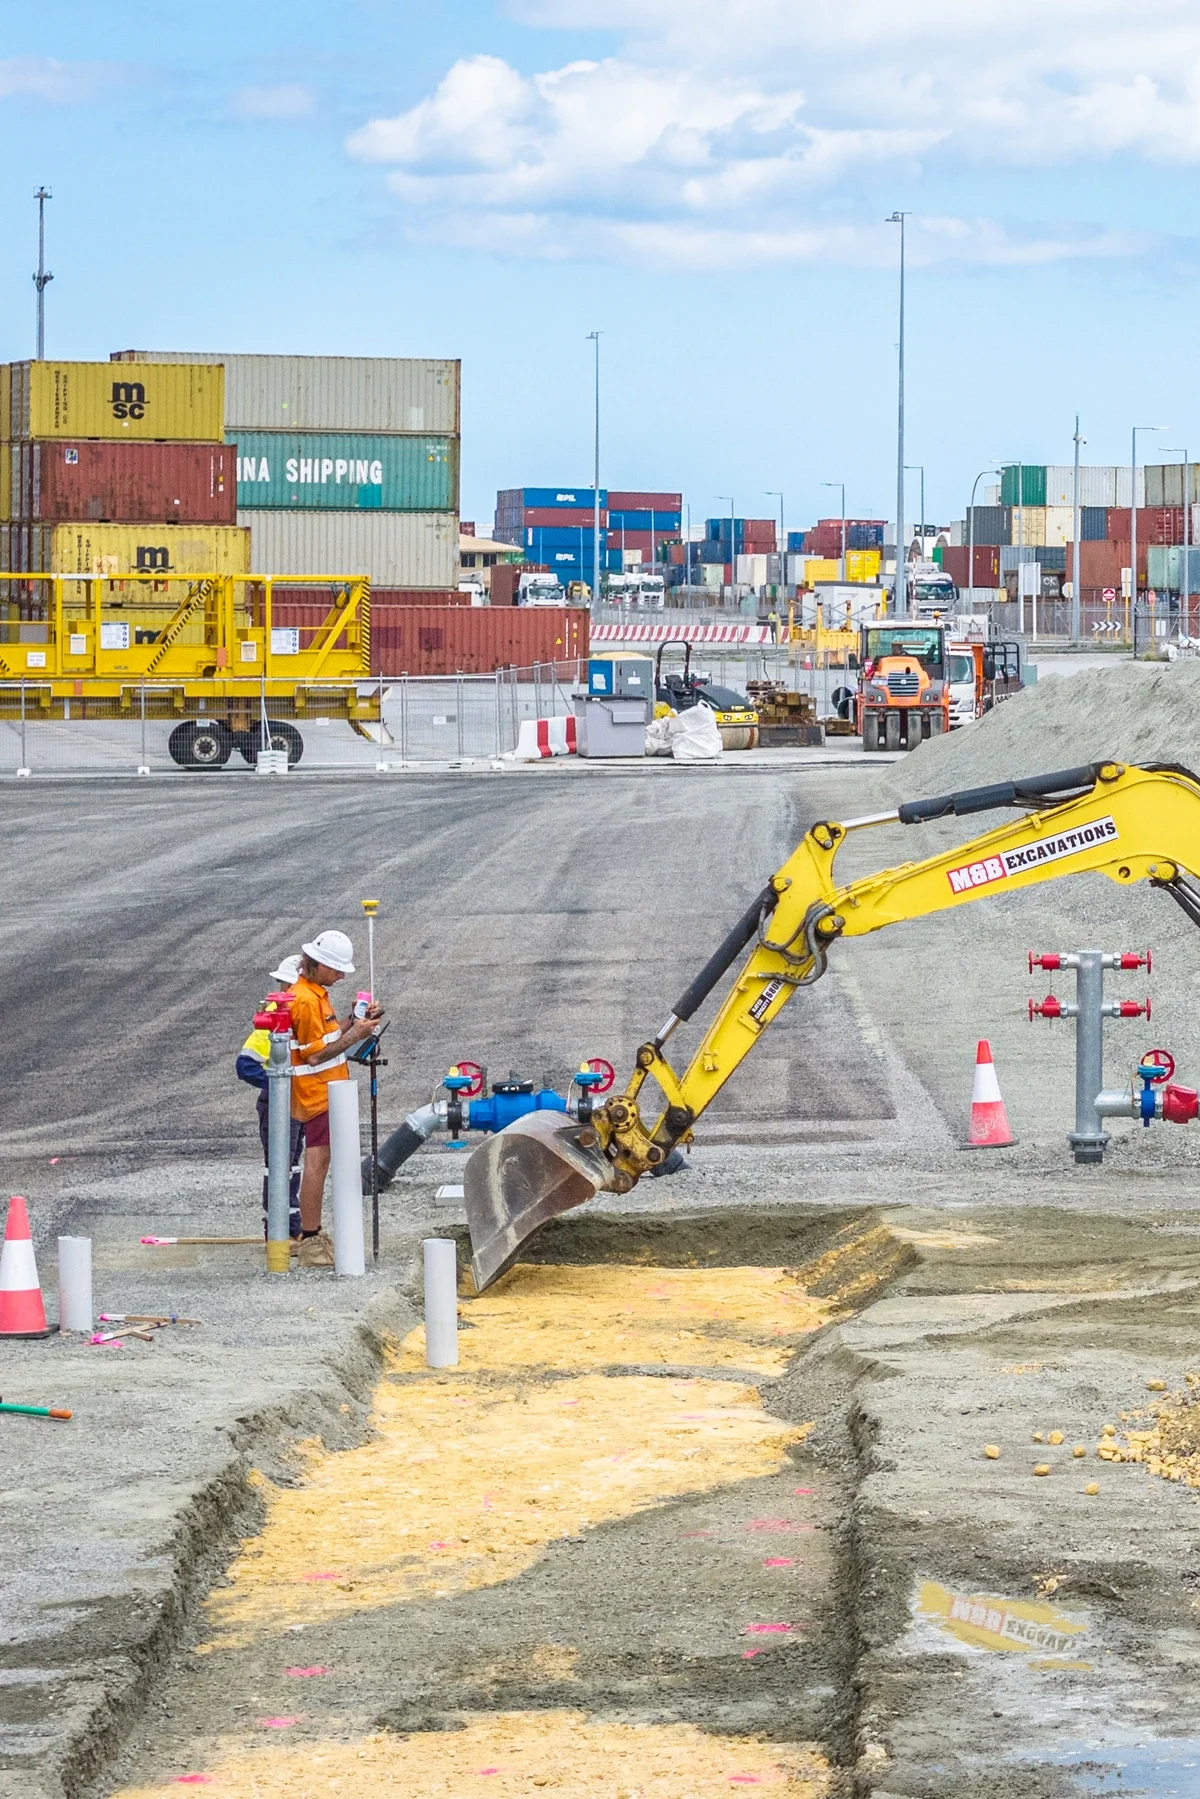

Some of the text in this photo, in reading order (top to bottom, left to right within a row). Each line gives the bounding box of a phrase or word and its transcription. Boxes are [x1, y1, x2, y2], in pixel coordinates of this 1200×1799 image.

[285, 457, 383, 485] SHIPPING
[949, 820, 1117, 893] M&B EXCAVATIONS
